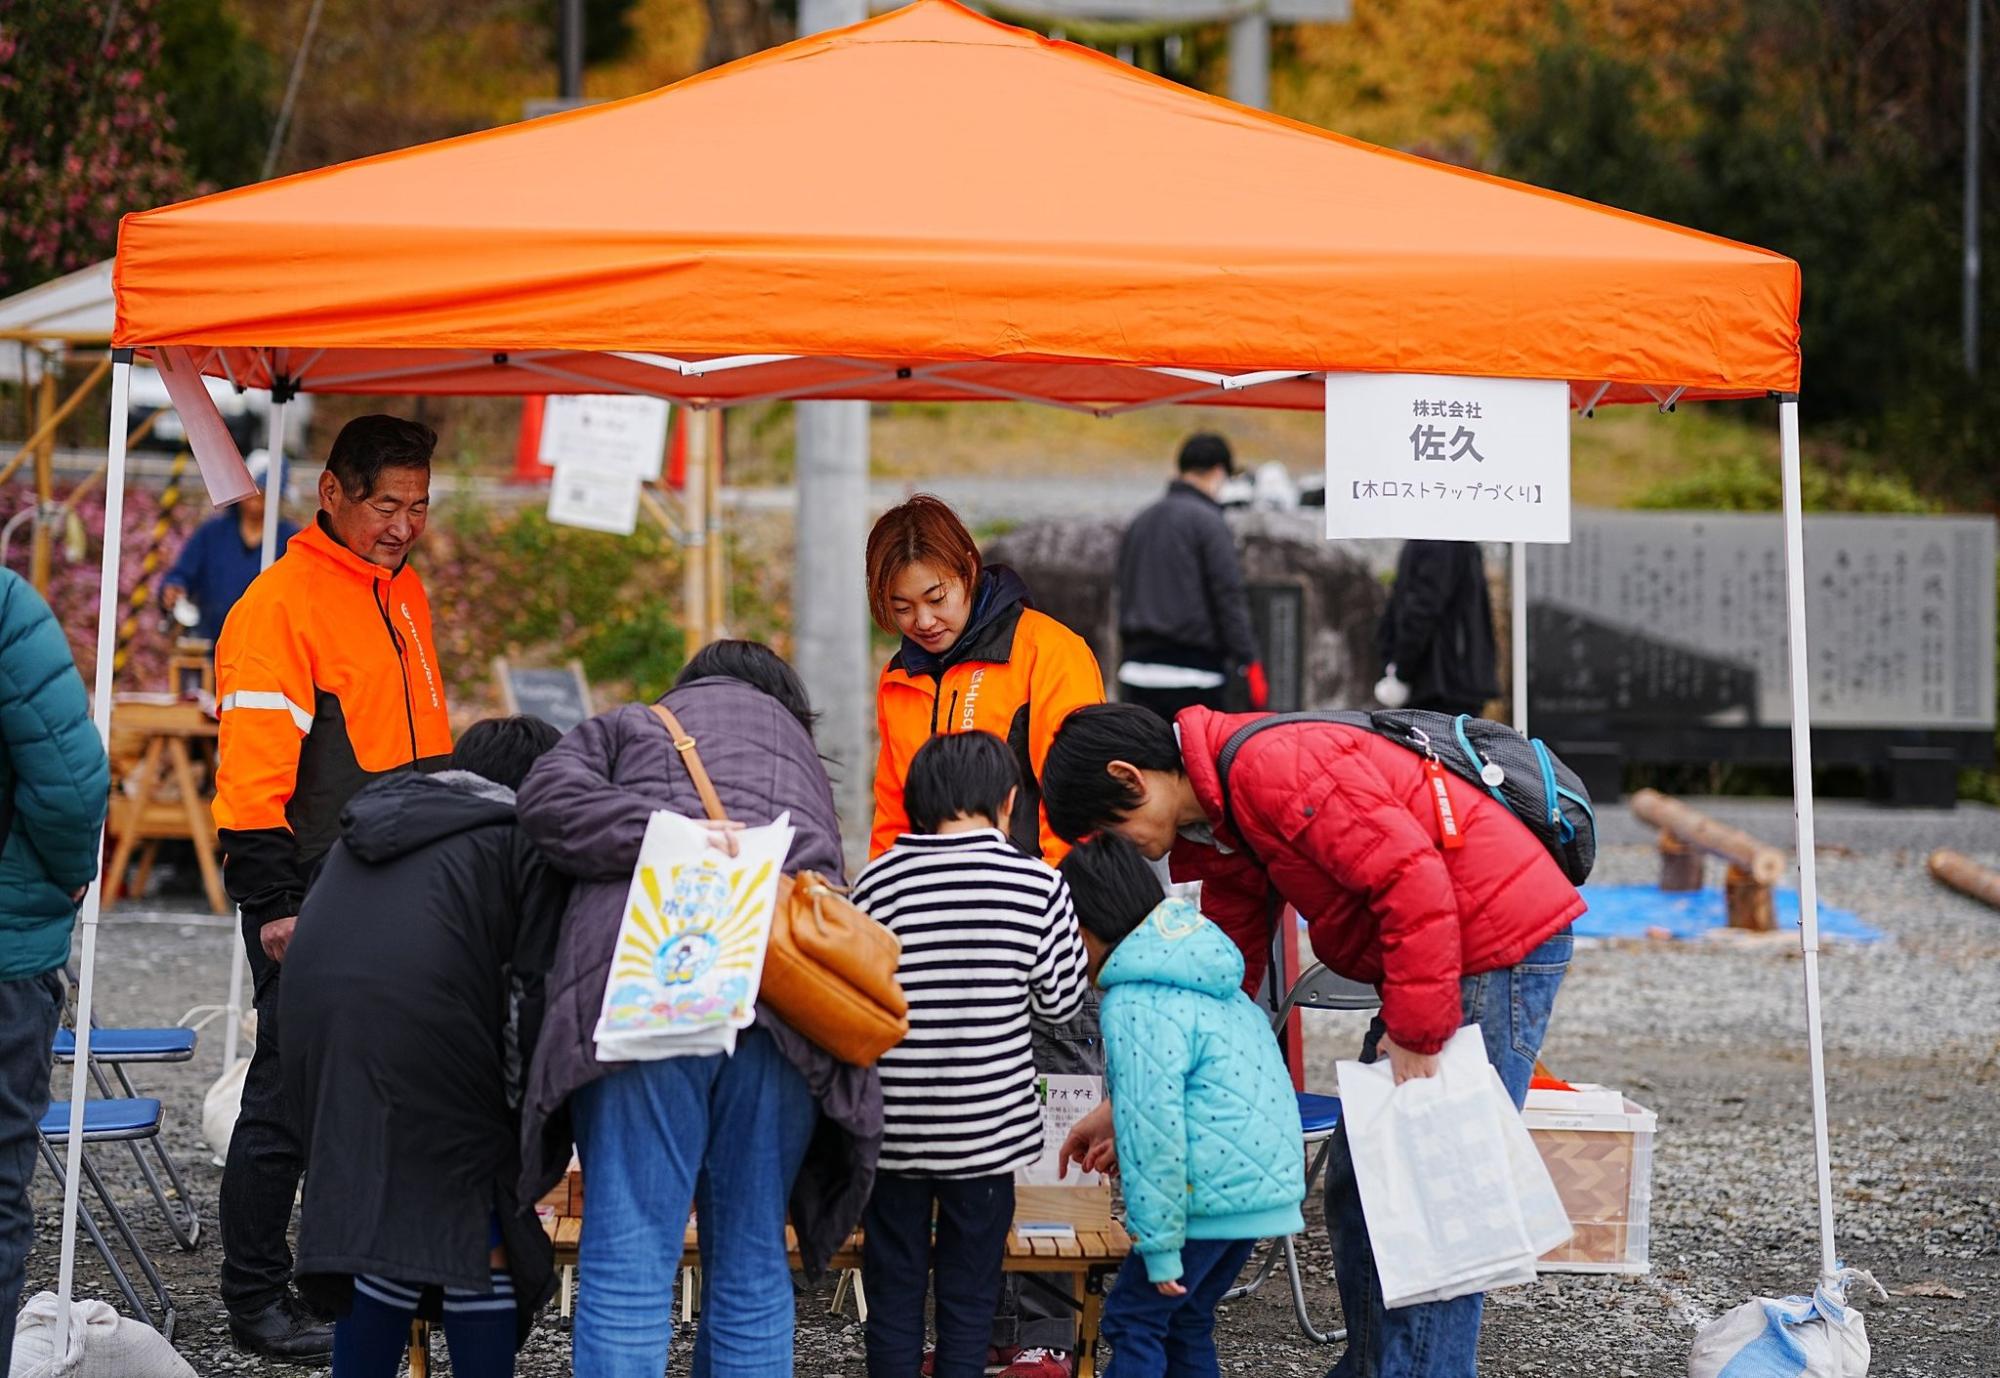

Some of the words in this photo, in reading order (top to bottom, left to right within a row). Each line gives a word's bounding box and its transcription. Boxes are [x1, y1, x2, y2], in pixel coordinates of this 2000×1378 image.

[1413, 399, 1482, 419] 株式会社
[1409, 424, 1484, 462] 佐久
[1048, 1088, 1093, 1100] アオダモ
